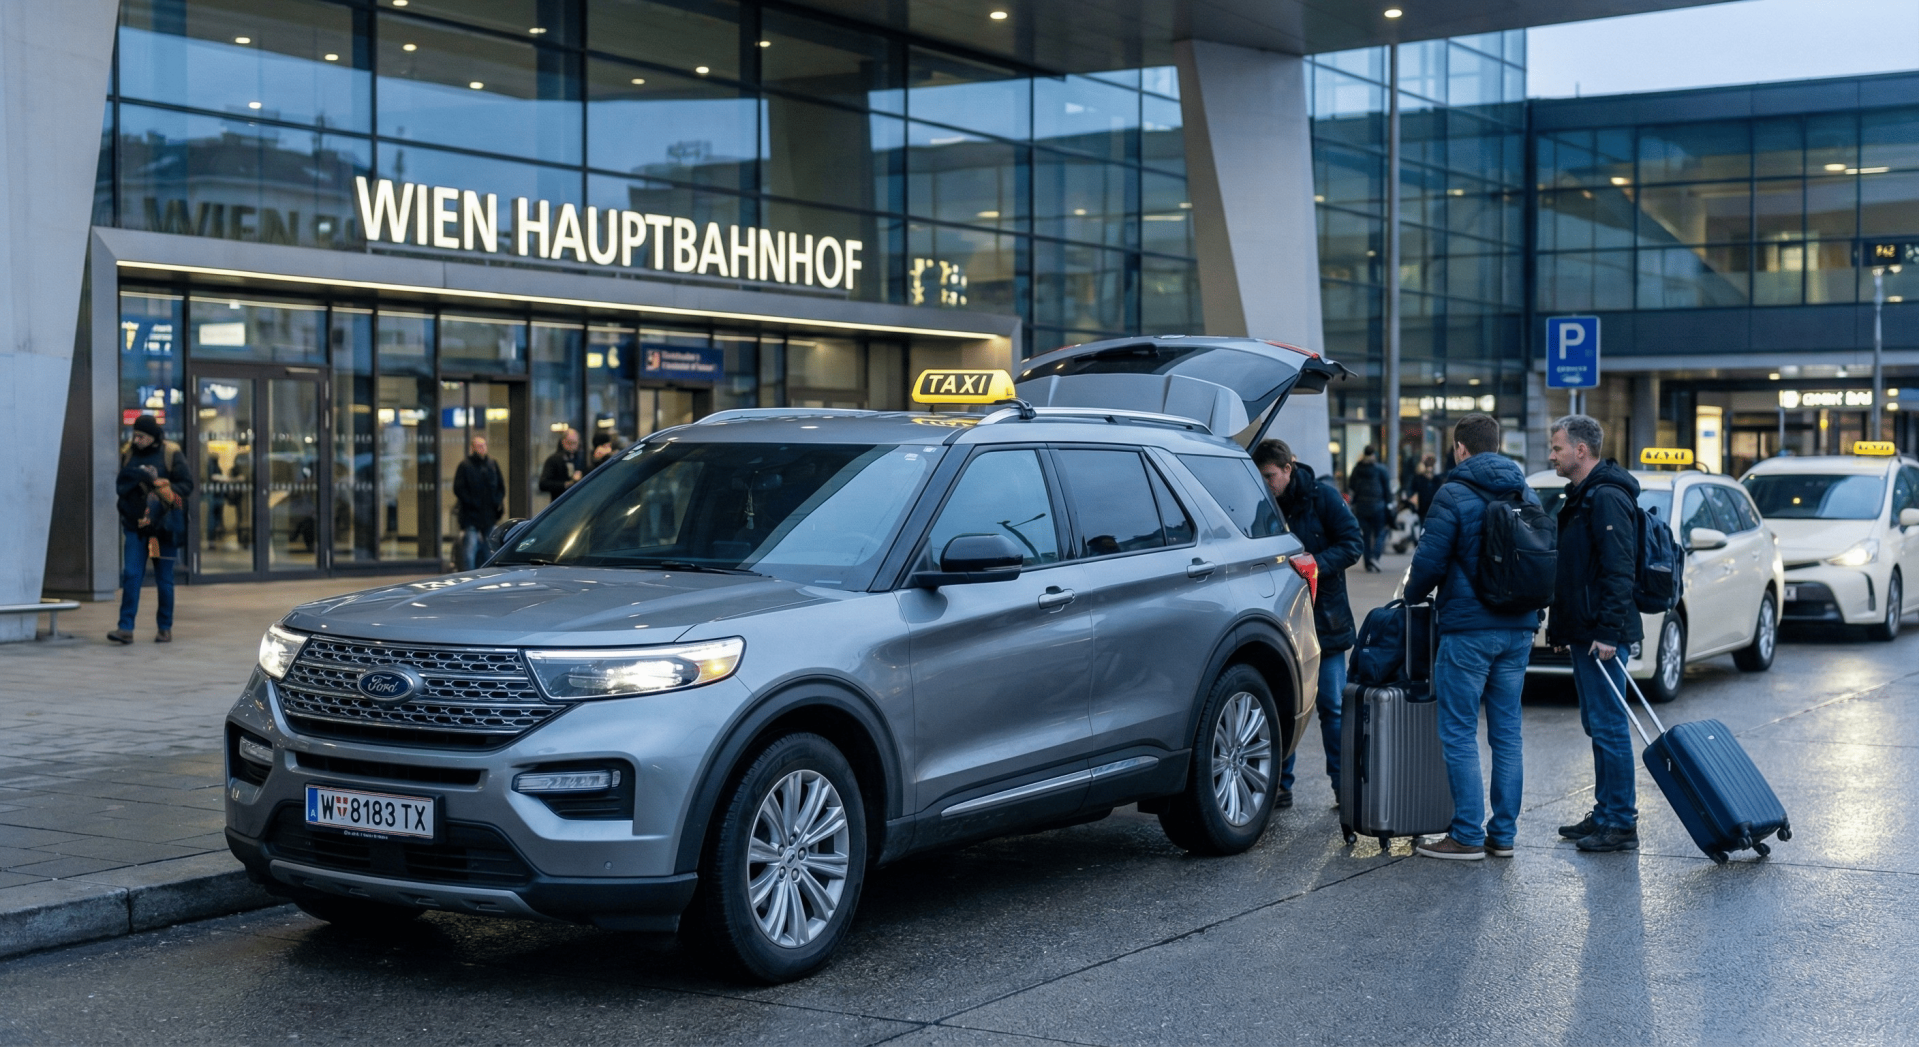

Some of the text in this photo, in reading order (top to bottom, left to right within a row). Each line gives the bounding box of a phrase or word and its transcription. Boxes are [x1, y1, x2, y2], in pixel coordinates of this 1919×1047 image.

[355, 176, 498, 253] WIEN
[516, 197, 863, 290] HAUPTBAHNHOF
[1559, 322, 1586, 360] P
[928, 374, 988, 394] TAXI
[368, 674, 399, 693] Ford
[310, 793, 426, 831] A W 8183 TX
